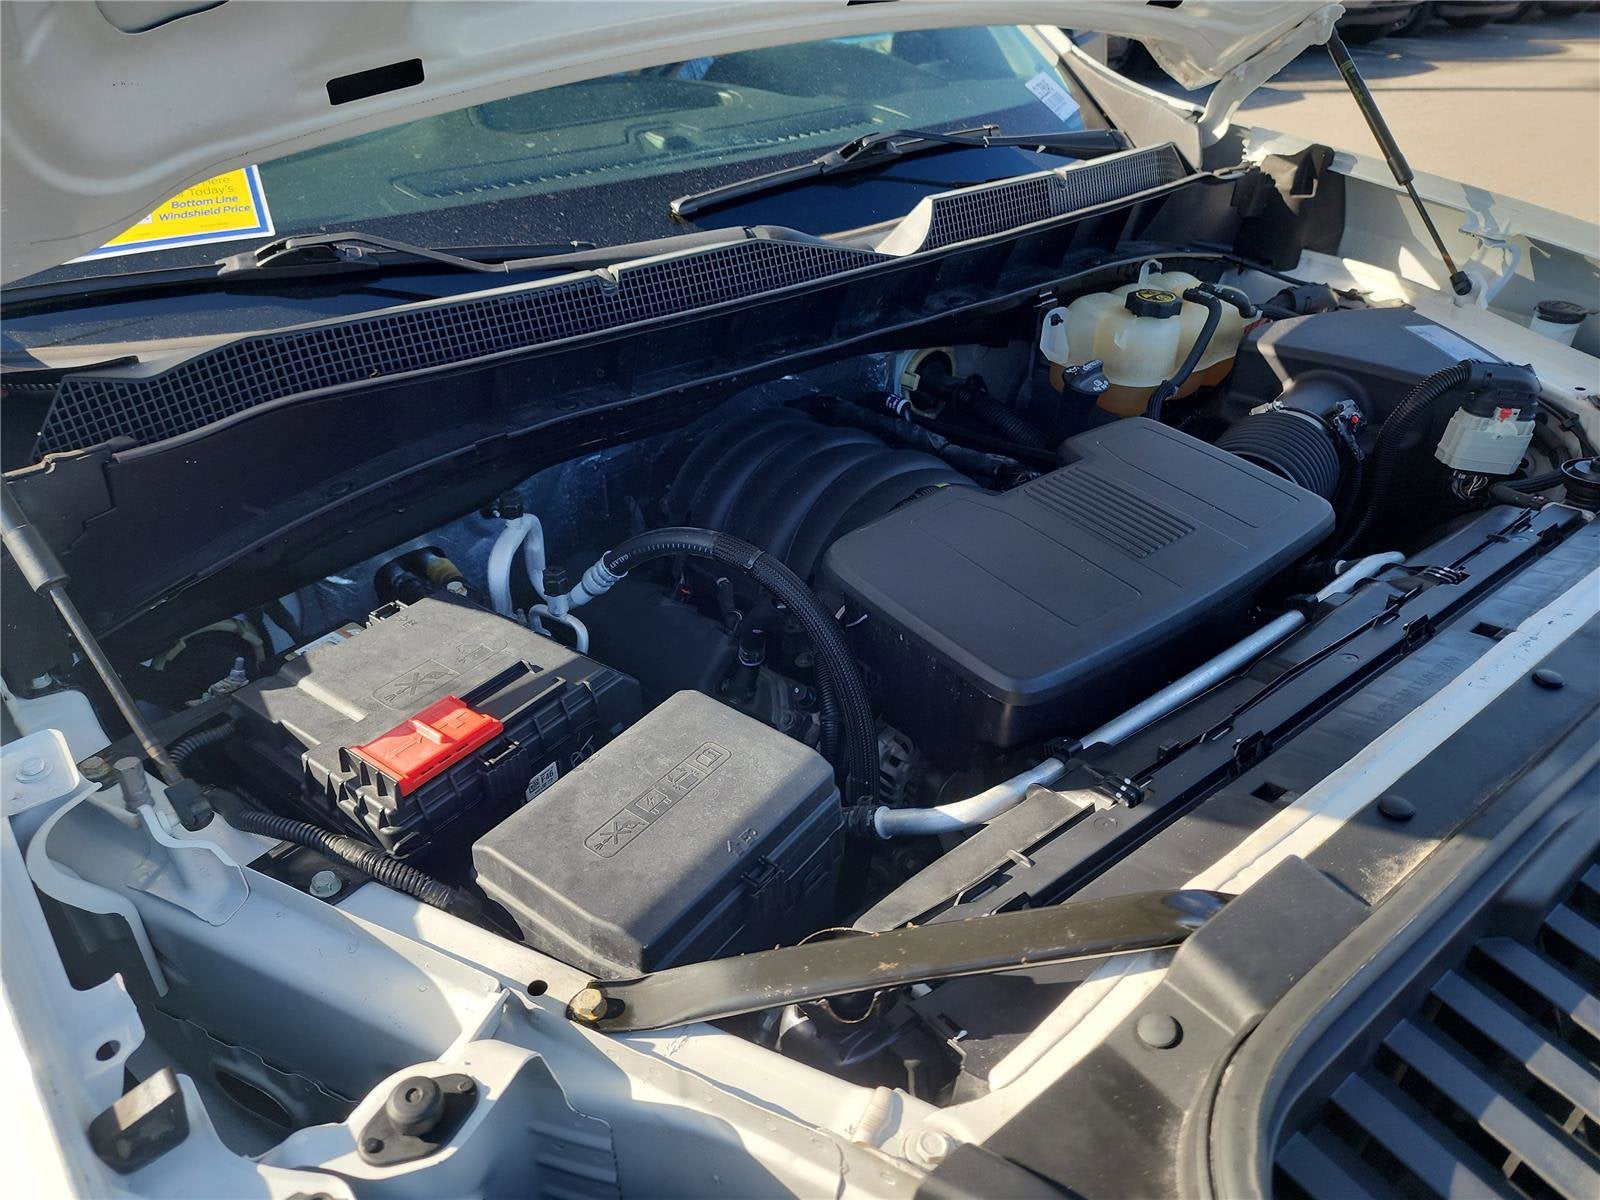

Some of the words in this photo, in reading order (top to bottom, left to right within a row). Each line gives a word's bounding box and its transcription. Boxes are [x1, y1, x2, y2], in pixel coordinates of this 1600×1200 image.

[189, 185, 234, 196] Today's
[171, 198, 213, 209] Bottom
[216, 196, 238, 204] Line
[159, 207, 221, 221] Windshield
[223, 205, 250, 213] Price
